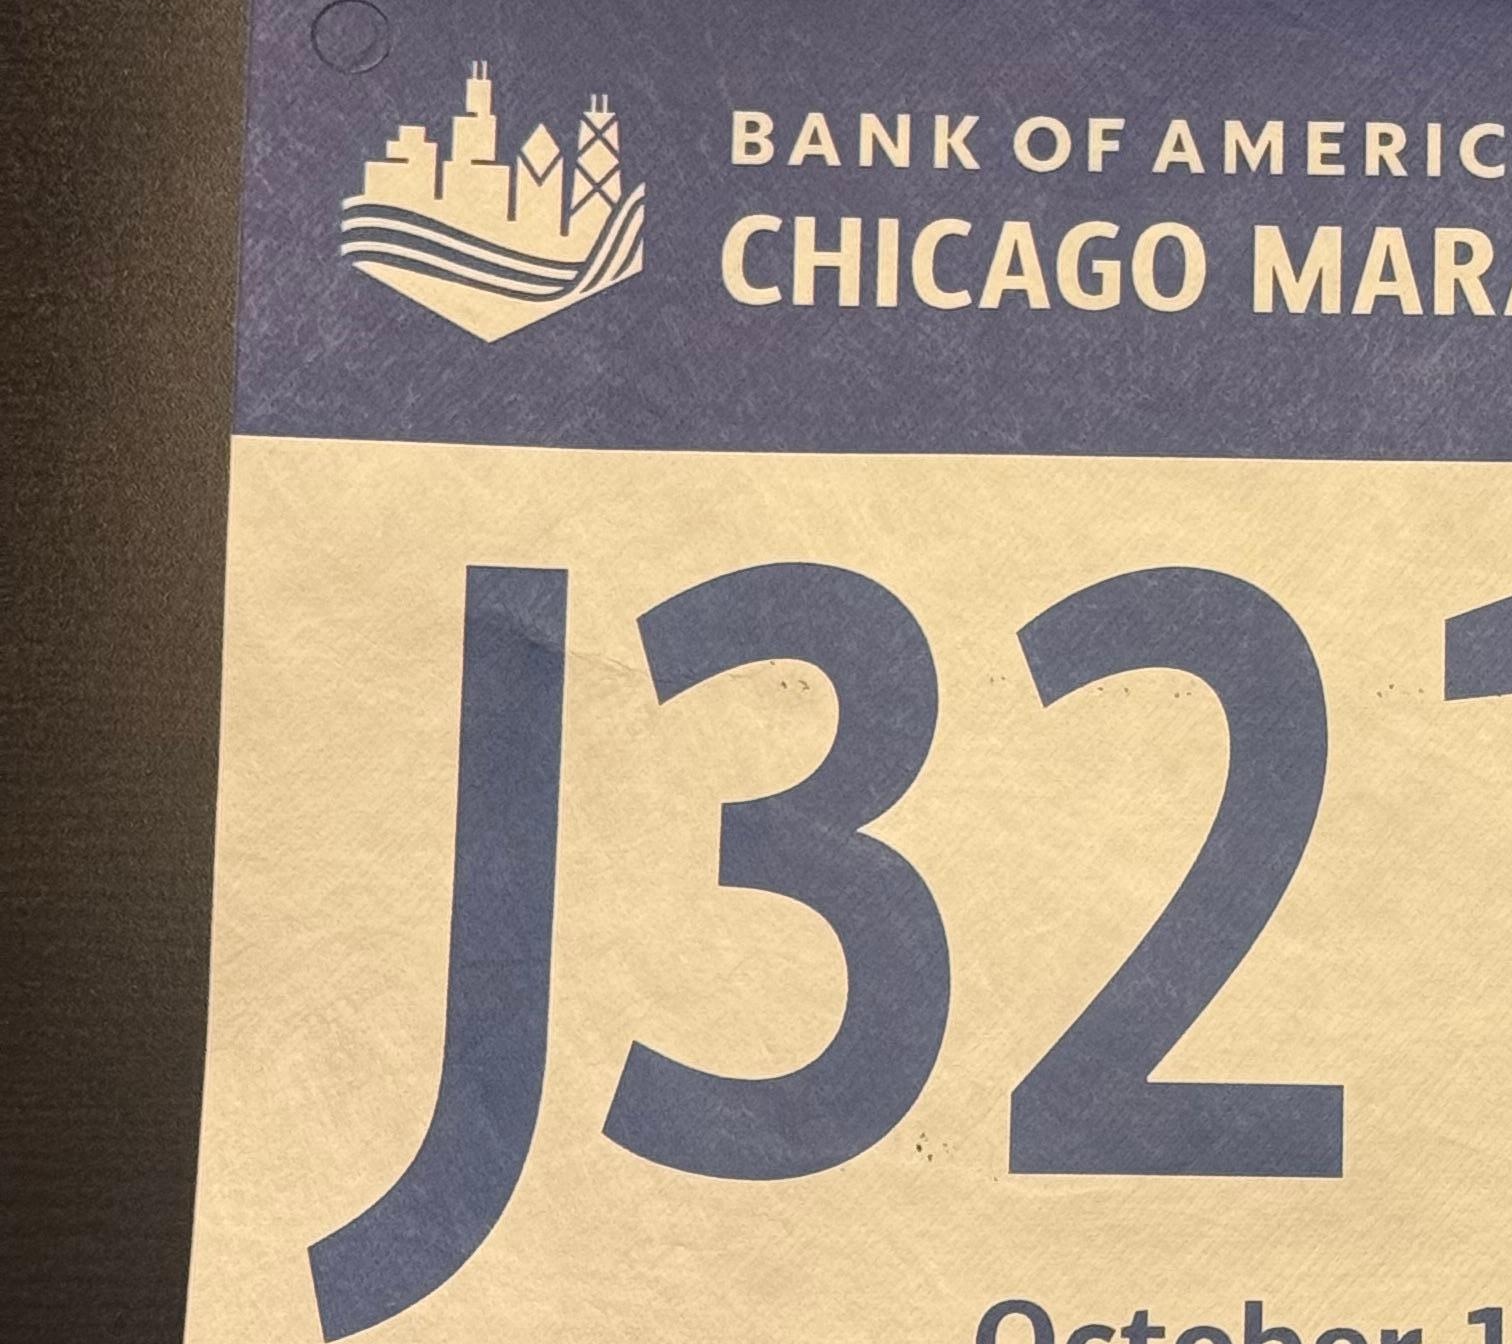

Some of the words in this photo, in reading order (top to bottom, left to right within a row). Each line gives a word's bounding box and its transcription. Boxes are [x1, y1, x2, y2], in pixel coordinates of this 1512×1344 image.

[731, 110, 981, 170] BANK
[1013, 115, 1126, 173] OF
[721, 214, 1207, 312] CHICAGO
